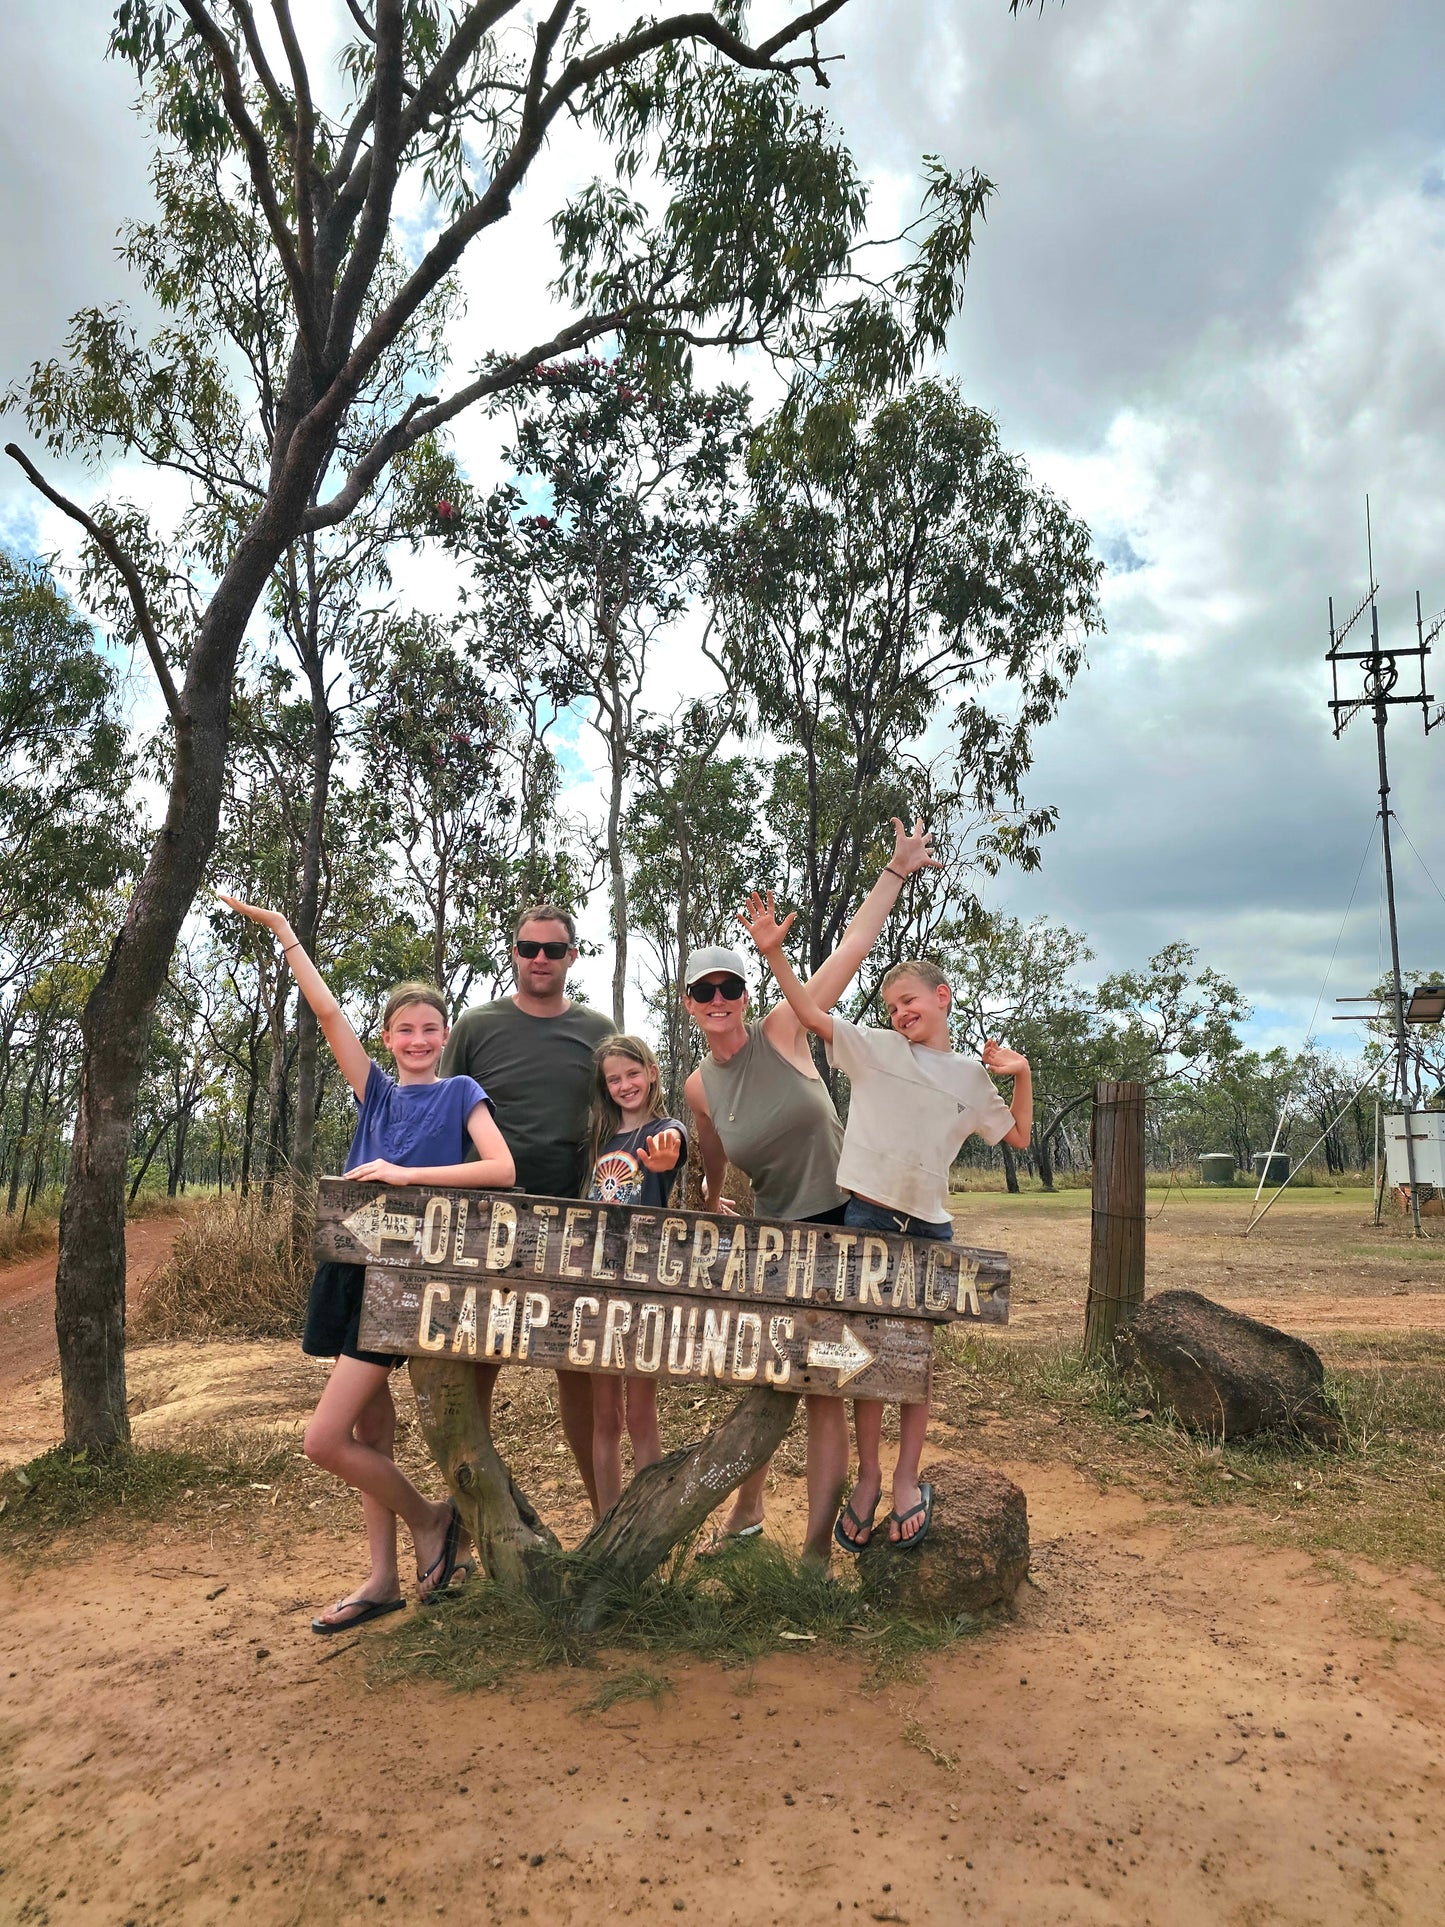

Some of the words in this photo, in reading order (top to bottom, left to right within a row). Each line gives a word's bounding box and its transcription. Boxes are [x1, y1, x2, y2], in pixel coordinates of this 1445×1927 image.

[421, 1196, 518, 1270] OLD
[533, 1204, 818, 1299] TELEGRAPH
[831, 1233, 981, 1316] TRACK
[418, 1282, 551, 1360] CAMP
[568, 1296, 795, 1385] GROUNDS
